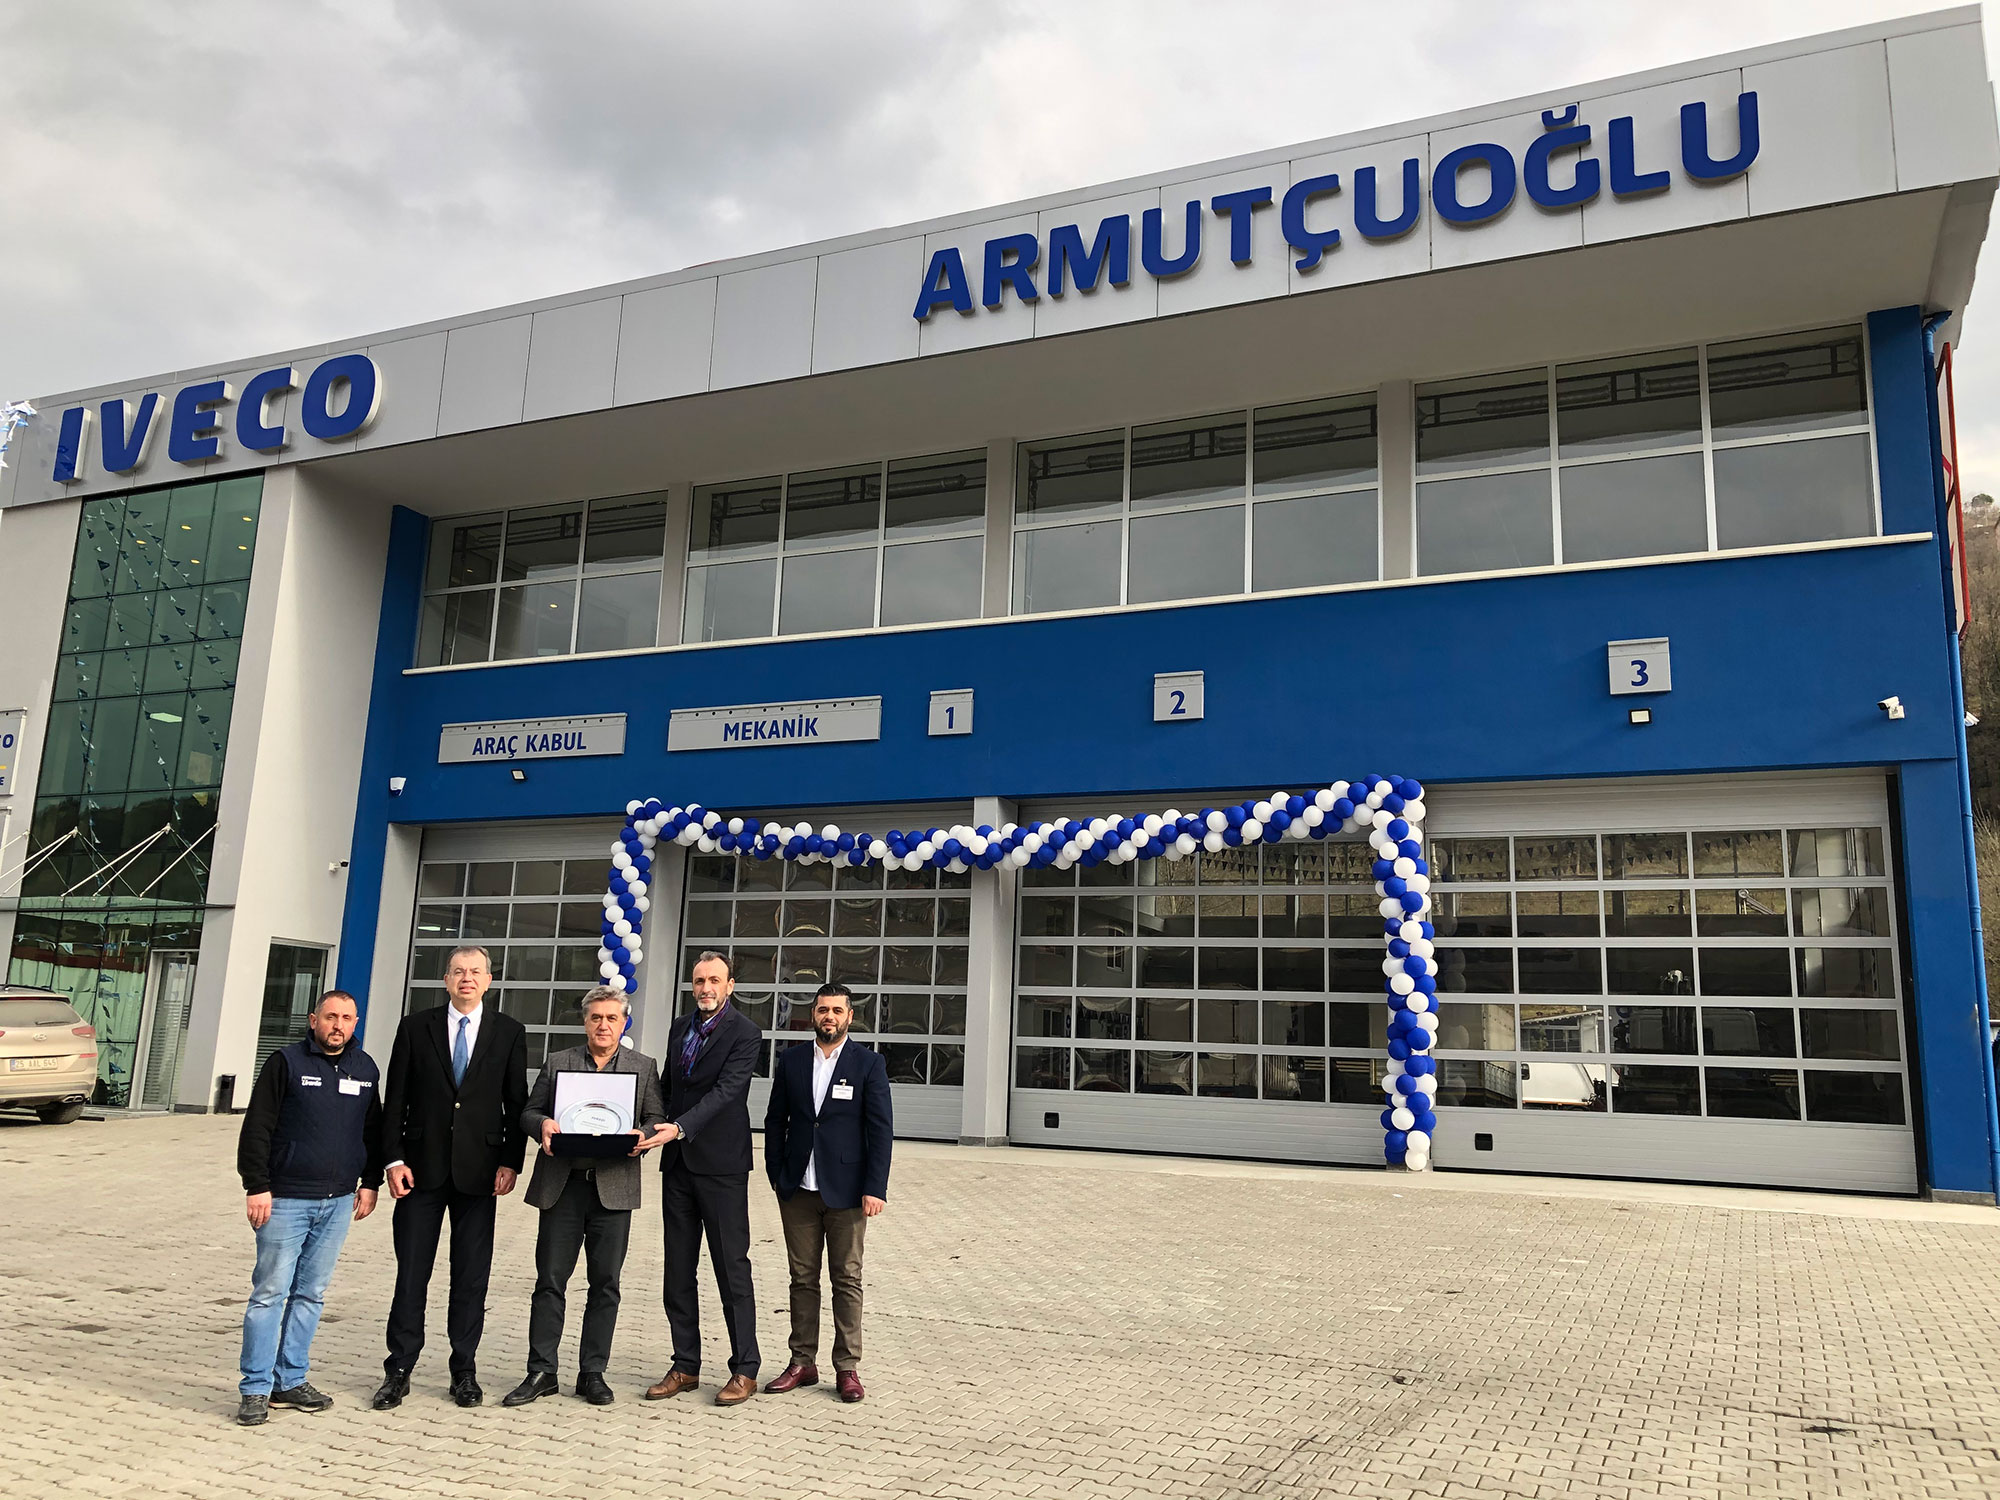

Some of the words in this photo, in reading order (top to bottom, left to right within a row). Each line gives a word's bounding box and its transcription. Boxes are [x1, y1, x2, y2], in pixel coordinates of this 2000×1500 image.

[913, 91, 1759, 320] ARMUTÇUOĞLU
[53, 354, 380, 482] IVECO
[1630, 659, 1649, 687] 3
[1169, 690, 1186, 715] 2
[723, 714, 819, 742] MEKANİK
[945, 706, 955, 729] 1
[472, 735, 518, 758] ARAÇ
[526, 732, 587, 752] KABUL
